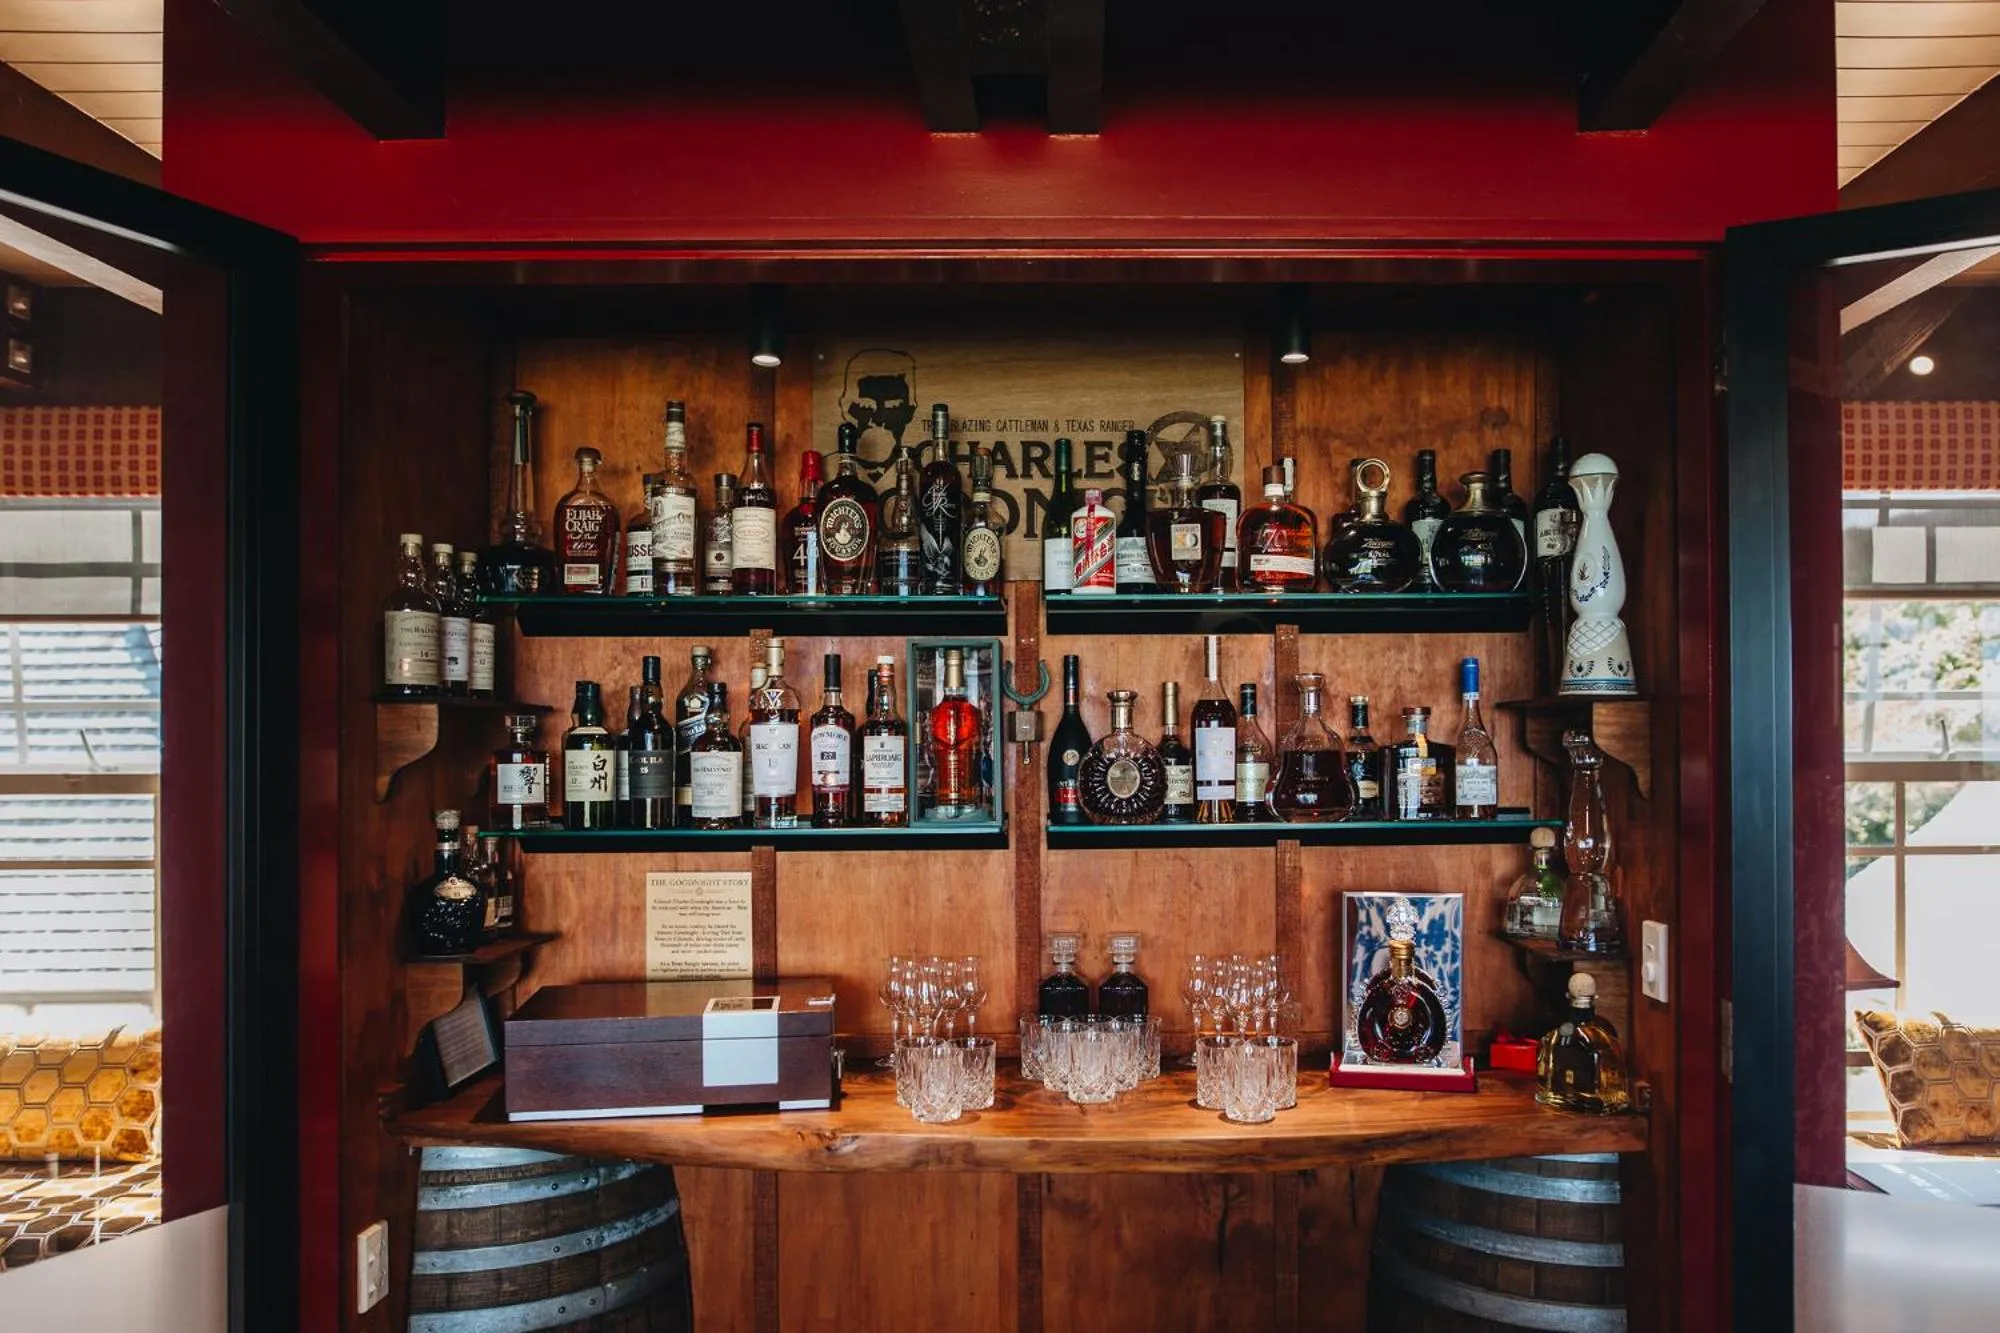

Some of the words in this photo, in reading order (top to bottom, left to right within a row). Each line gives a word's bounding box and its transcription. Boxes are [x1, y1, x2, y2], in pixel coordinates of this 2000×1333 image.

[921, 419, 991, 433] TRBLAZING
[996, 419, 1049, 433] CATTLEMAN
[1054, 420, 1060, 433] &
[1066, 419, 1095, 433] TEXAS
[1100, 419, 1135, 433] RANGER
[565, 508, 603, 520] ELIJAH
[565, 520, 600, 534] CRAIG
[590, 754, 608, 793] 白州
